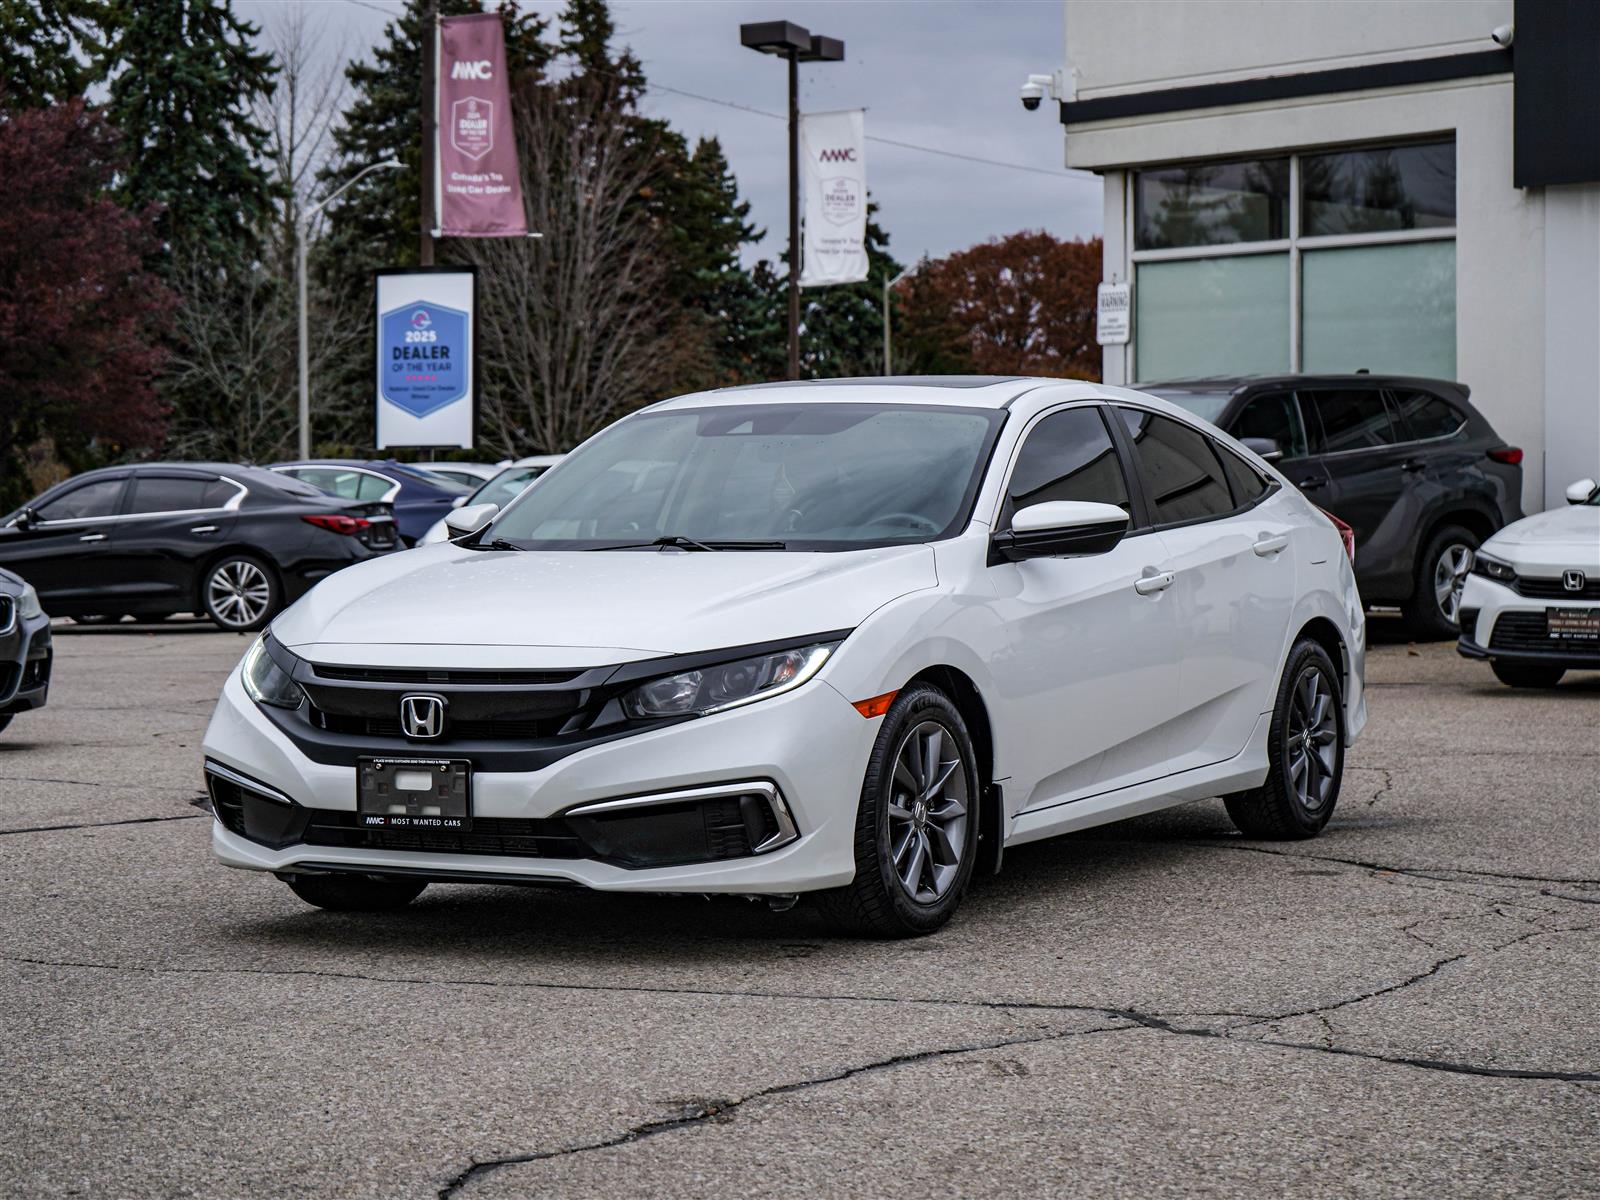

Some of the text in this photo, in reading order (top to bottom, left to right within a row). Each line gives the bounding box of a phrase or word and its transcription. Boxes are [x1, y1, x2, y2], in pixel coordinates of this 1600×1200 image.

[405, 331, 437, 343] 2025
[392, 345, 450, 361] DEALER
[392, 362, 452, 373] OF THE YEAR
[391, 817, 410, 825] MOST
[413, 818, 441, 826] WANTED
[444, 819, 461, 827] CARS
